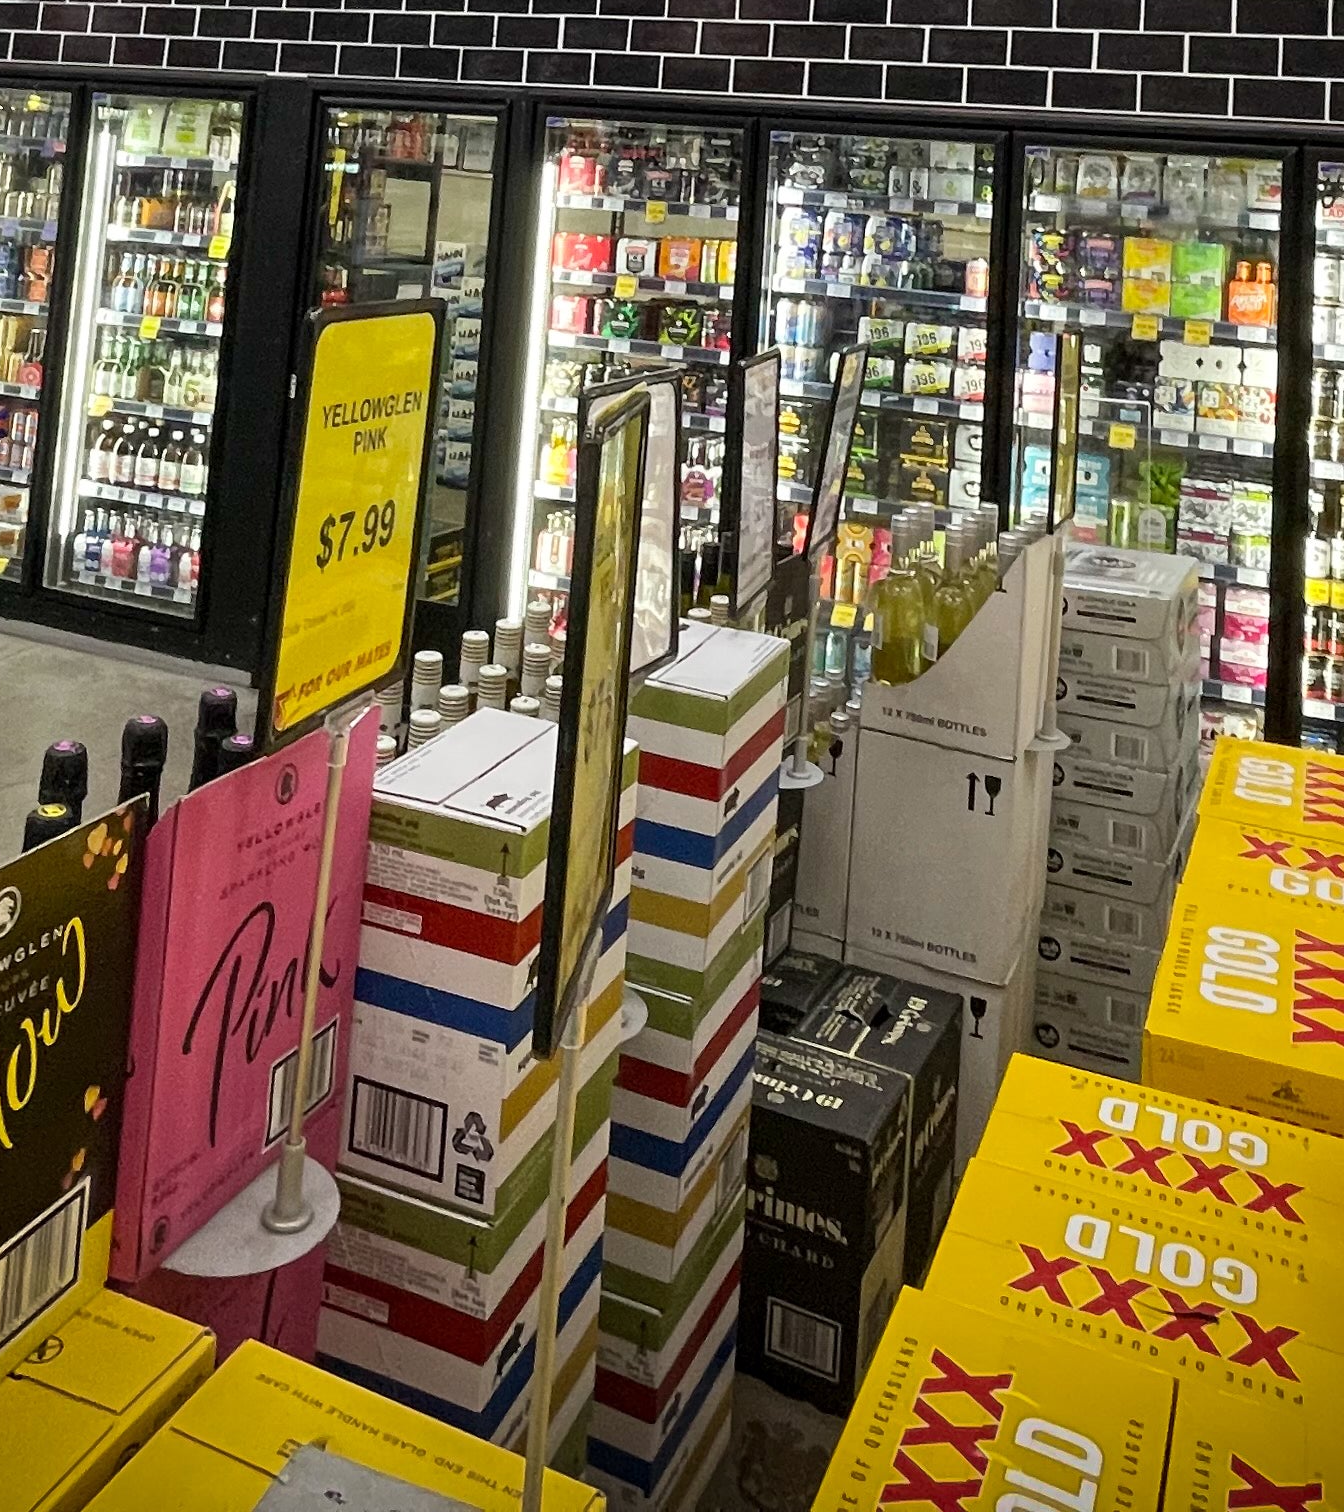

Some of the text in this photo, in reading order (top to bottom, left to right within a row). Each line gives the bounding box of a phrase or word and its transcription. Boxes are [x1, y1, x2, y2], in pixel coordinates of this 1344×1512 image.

[322, 390, 423, 430] YELLOWGLEN
[352, 424, 389, 457] PINK
[316, 498, 397, 575] $7.99
[297, 639, 393, 705] FOR OUR MATES
[937, 717, 989, 739] BOTTLES
[1233, 755, 1296, 807] GOLD
[926, 939, 978, 965] BOTTLES
[1199, 924, 1282, 1015] GOLD
[1097, 1095, 1269, 1167] GOLD
[1049, 1117, 1306, 1225] XXXX
[746, 1185, 849, 1246] rimes.
[1063, 1212, 1259, 1305] GOLD
[1006, 1242, 1302, 1384] XXXX
[875, 1347, 1015, 1512] XXX
